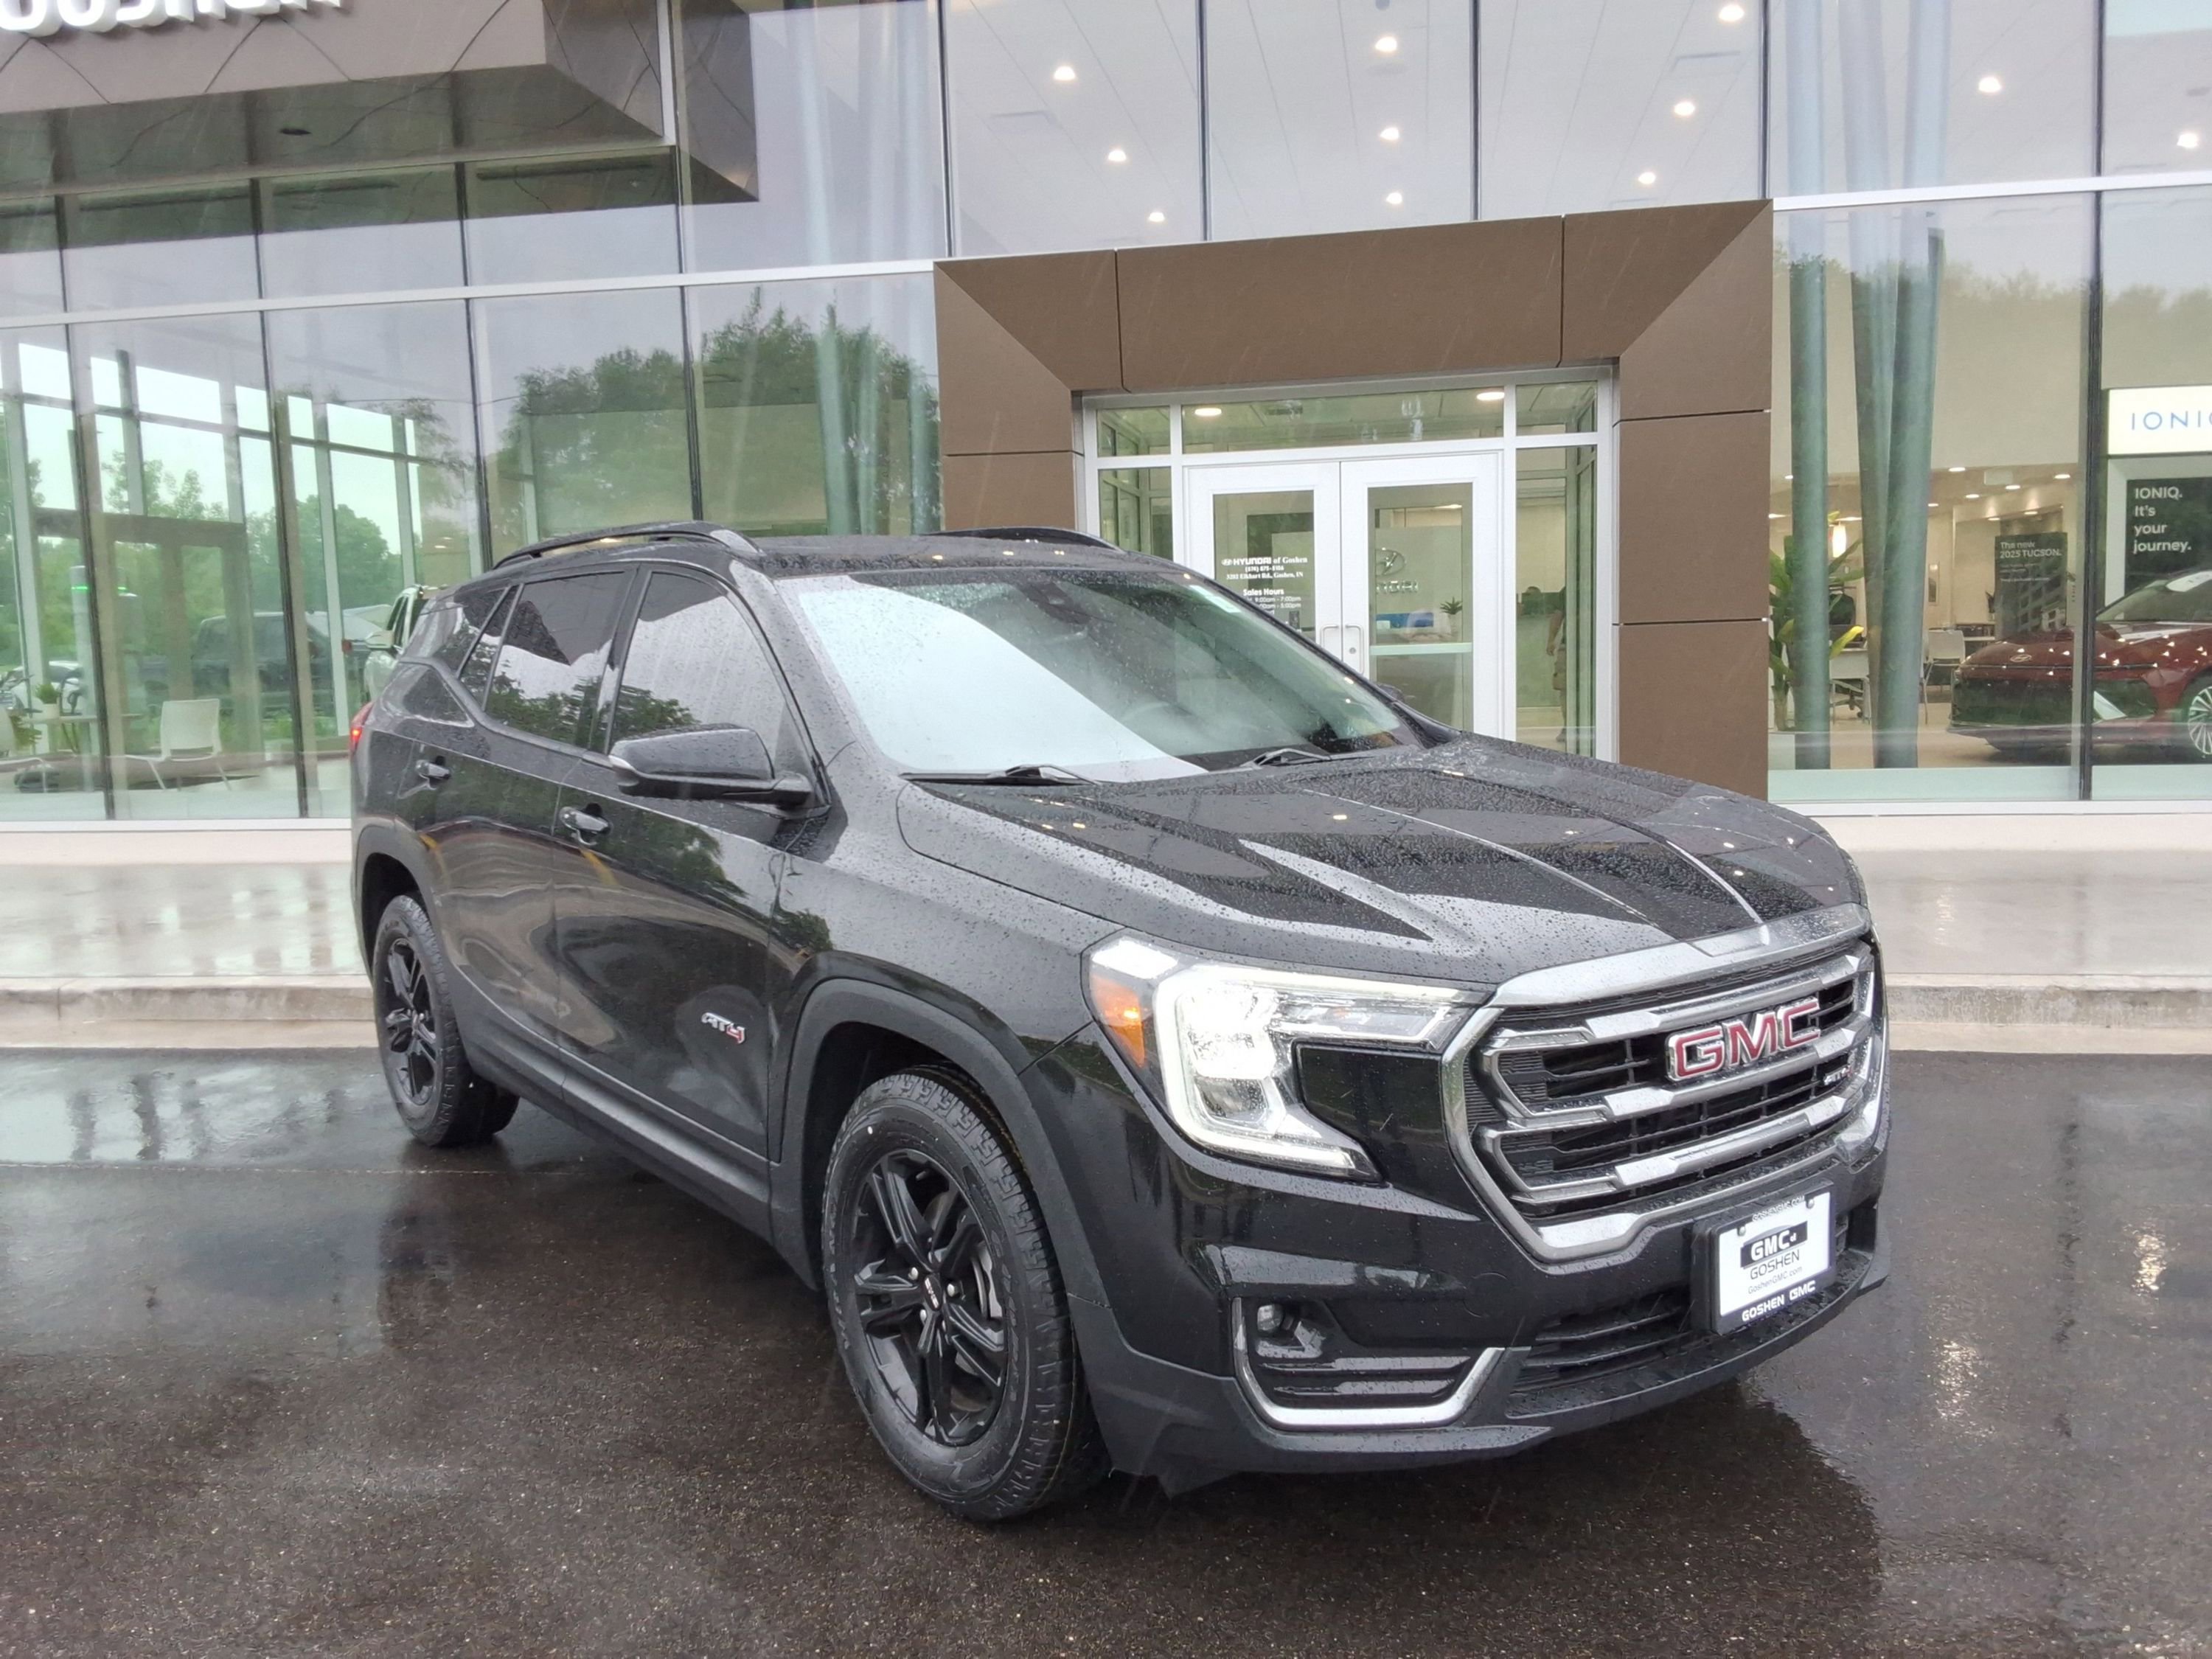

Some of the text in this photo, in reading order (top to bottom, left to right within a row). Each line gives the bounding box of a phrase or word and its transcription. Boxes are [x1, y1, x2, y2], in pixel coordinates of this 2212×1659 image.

[2132, 411, 2212, 430] IONI
[2135, 487, 2183, 500] IONIQ.
[2135, 506, 2156, 516] It's
[2134, 524, 2167, 536] your
[2132, 540, 2191, 554] journey.
[1233, 557, 1272, 566] HYUNDAI
[1282, 556, 1308, 564] Goshen
[1666, 997, 1821, 1082] GMC
[1750, 1229, 1790, 1262] GMC
[1750, 1249, 1800, 1280] GOSHEN
[1742, 1280, 1816, 1322] GOSHEN GMC
